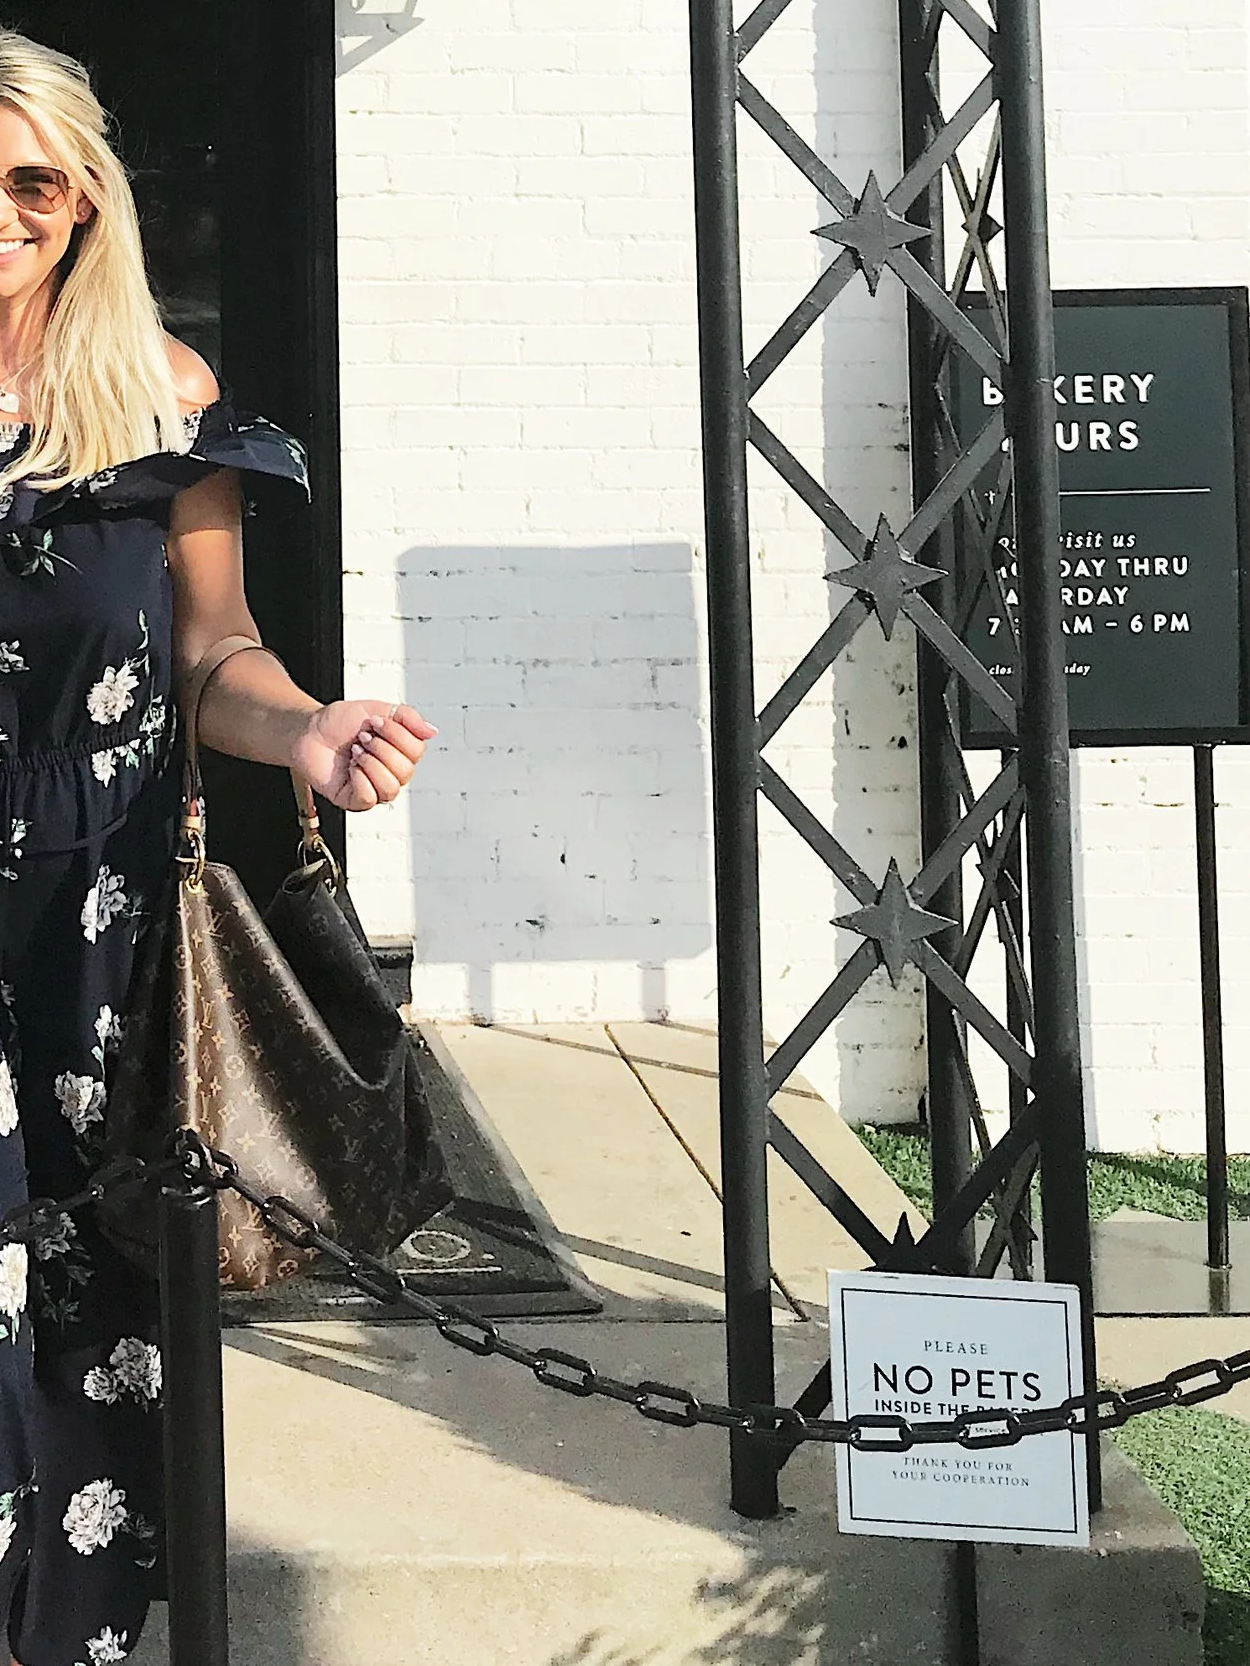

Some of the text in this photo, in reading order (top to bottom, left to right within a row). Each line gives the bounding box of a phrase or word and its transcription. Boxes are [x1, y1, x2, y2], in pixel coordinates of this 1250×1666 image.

[982, 373, 1155, 405] BKERY
[1112, 534, 1137, 549] us
[1117, 556, 1189, 577] THRU
[1129, 614, 1144, 633] 6
[1153, 613, 1190, 632] PM
[923, 1340, 989, 1355] PLEASE
[873, 1362, 1042, 1402] NO PETS
[874, 1398, 932, 1416] INSIDE
[937, 1403, 970, 1417] THE
[903, 1456, 1013, 1472] THANK YOU FOR
[892, 1470, 1030, 1487] YOUR COOPERATION
